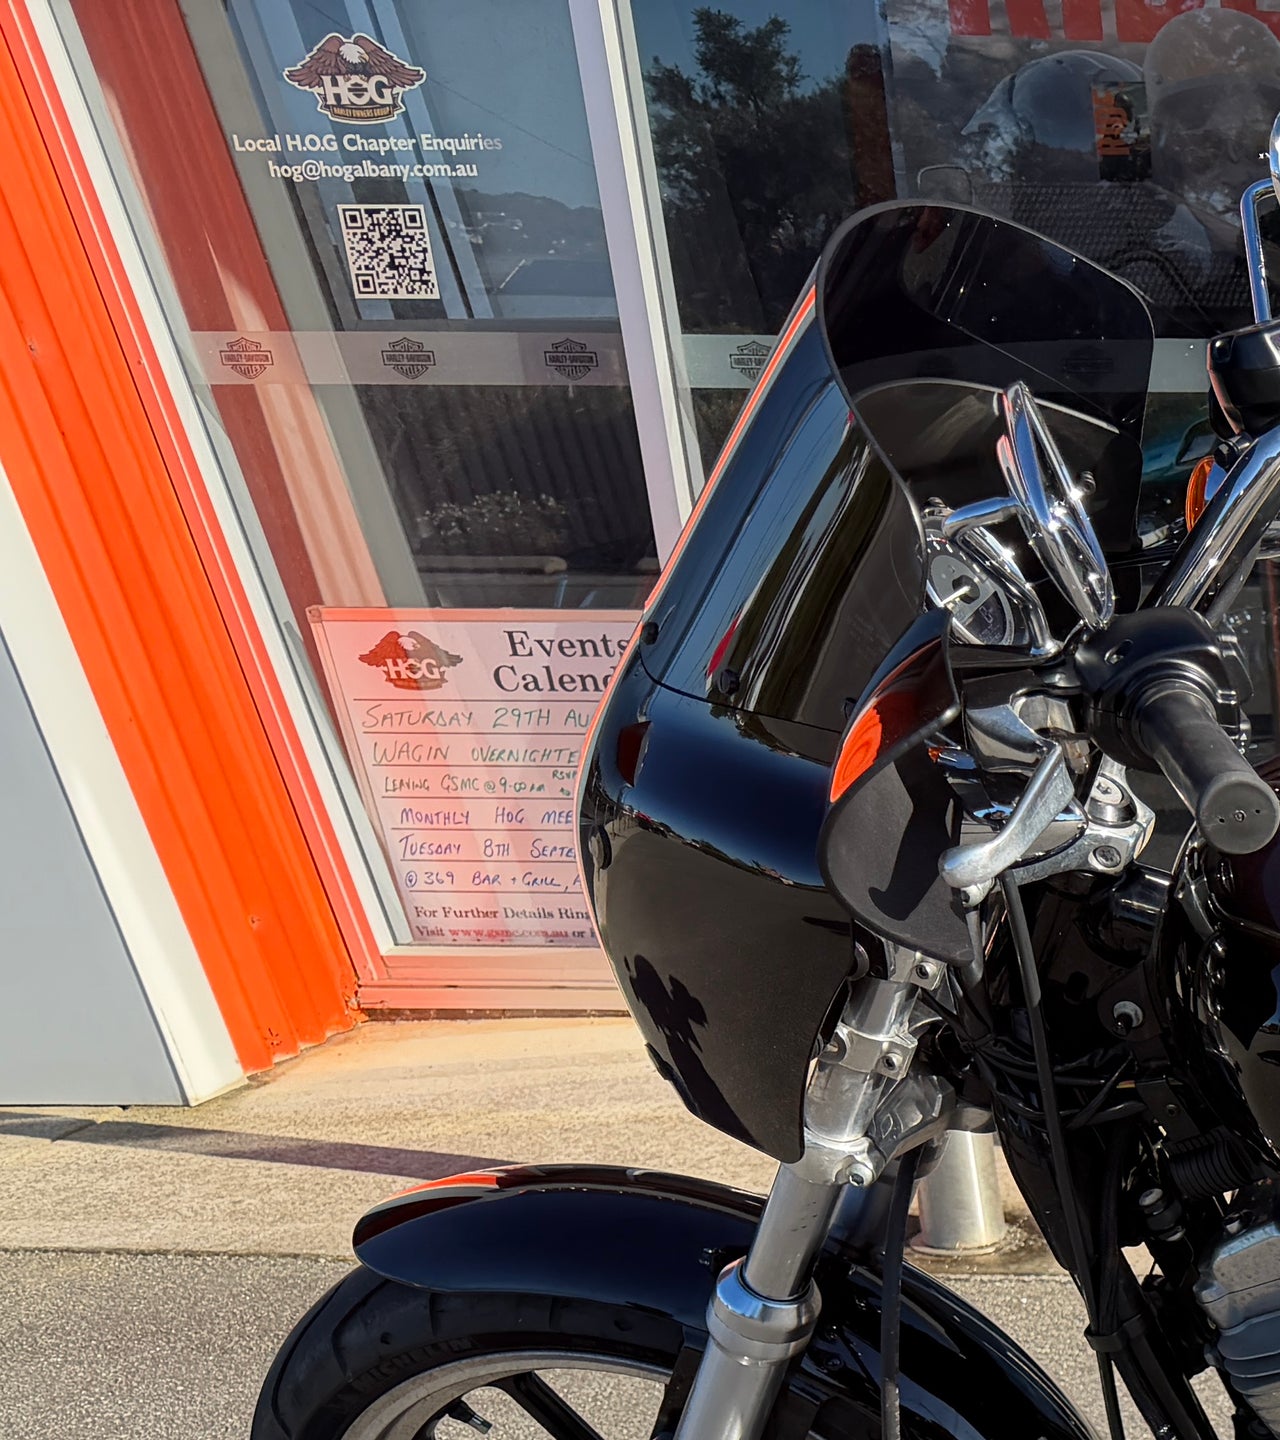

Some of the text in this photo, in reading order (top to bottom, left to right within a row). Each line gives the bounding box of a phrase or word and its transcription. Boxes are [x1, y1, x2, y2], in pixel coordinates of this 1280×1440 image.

[320, 74, 393, 105] HOG
[232, 133, 503, 157] Local H.O.G Chapter Enquiries
[268, 160, 478, 182] hog@hogalbany.com.au
[504, 629, 631, 658] Events
[384, 657, 441, 680] HOG
[361, 703, 473, 728] SATURDAY
[492, 706, 551, 730] 29TH
[372, 740, 449, 764] WAGIN
[384, 775, 430, 792] LEAVING
[400, 806, 573, 826] MONTHLY HOG MEE
[399, 833, 461, 859] TUESDAY
[484, 839, 510, 858] 8TH
[423, 871, 455, 886] 369
[471, 870, 502, 886] BAR
[414, 906, 438, 919] For
[442, 906, 499, 919] Further
[502, 906, 554, 920] Details
[415, 926, 445, 937] Visit
[572, 929, 586, 938] or
